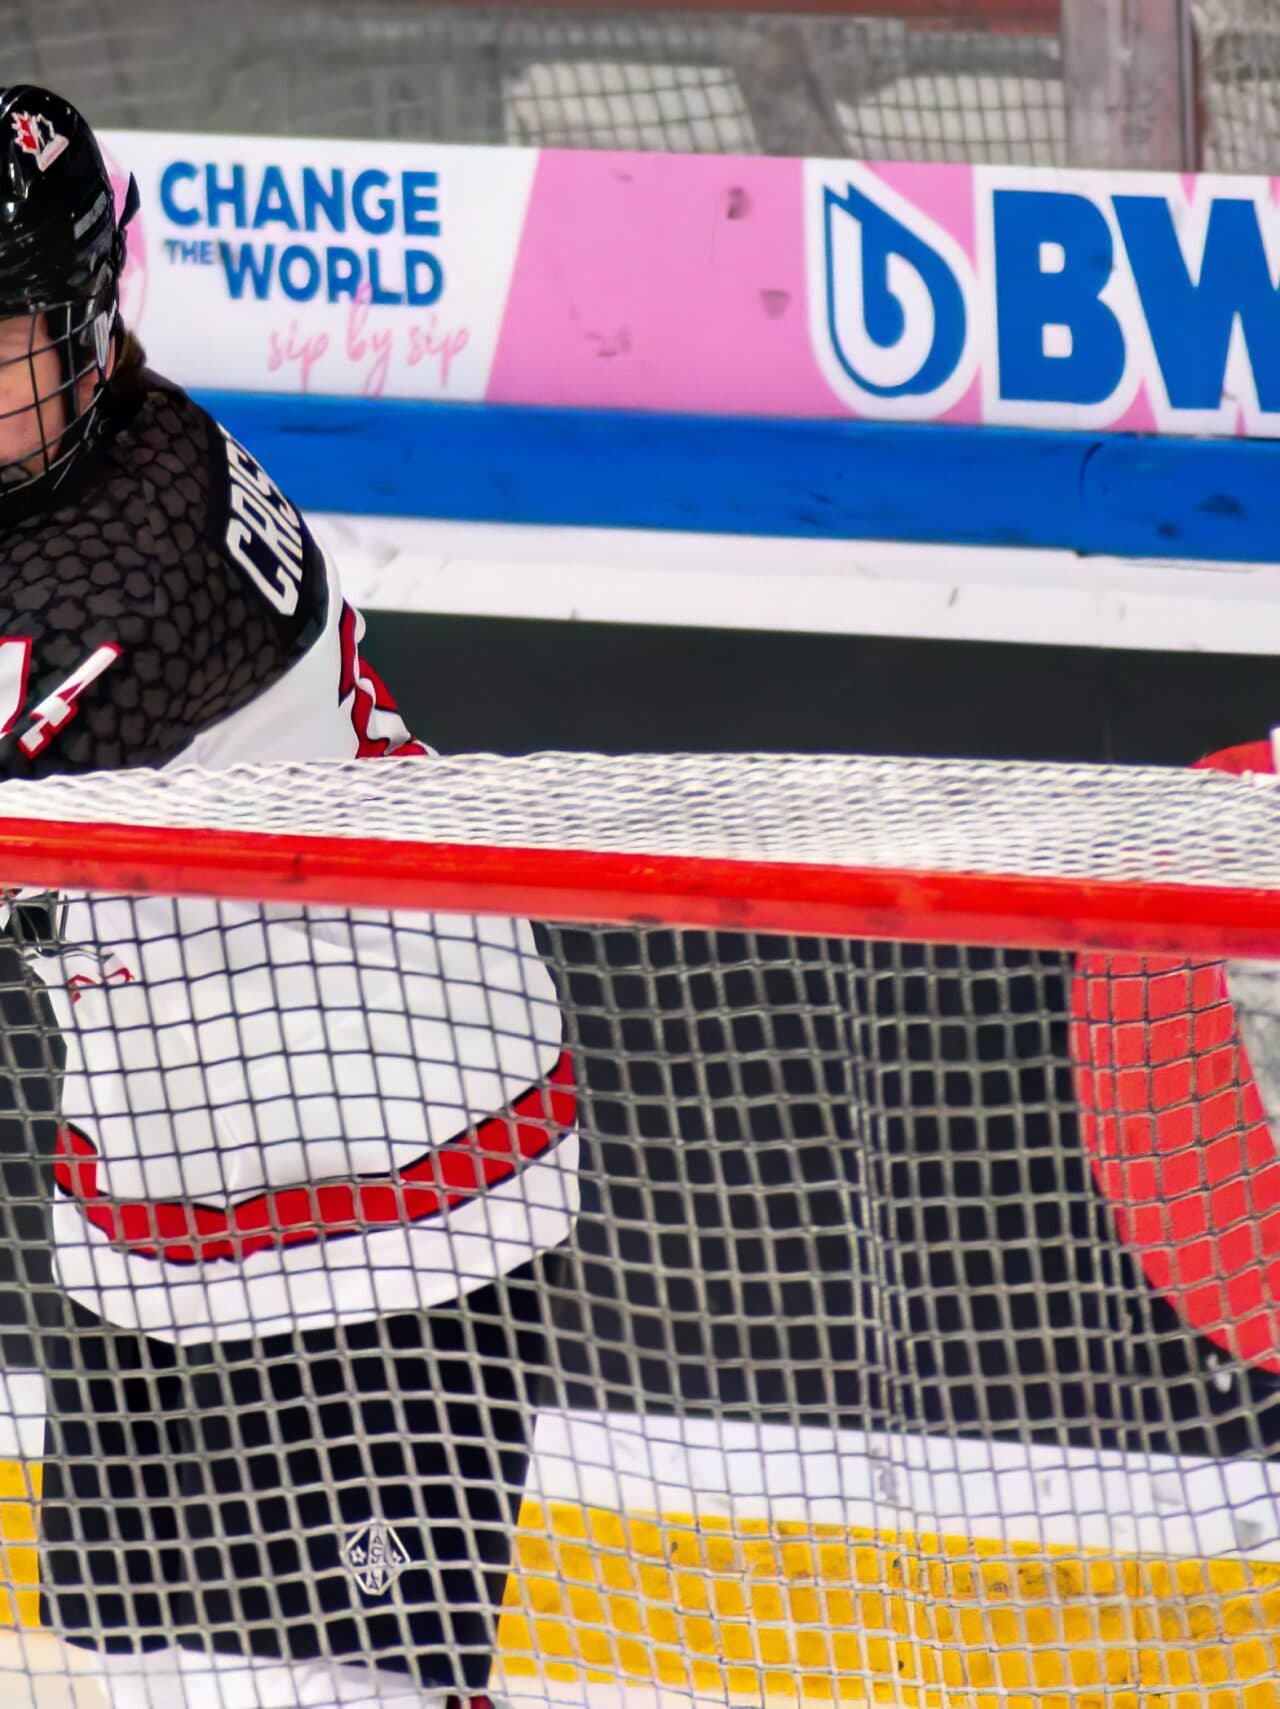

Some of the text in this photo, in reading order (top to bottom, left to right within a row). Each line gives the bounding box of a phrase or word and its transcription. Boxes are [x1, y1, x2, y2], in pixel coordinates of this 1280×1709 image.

[160, 161, 441, 238] CHANGE
[164, 238, 444, 307] THE WORLD
[267, 280, 470, 397] sip by sip
[217, 421, 304, 617] CRIS
